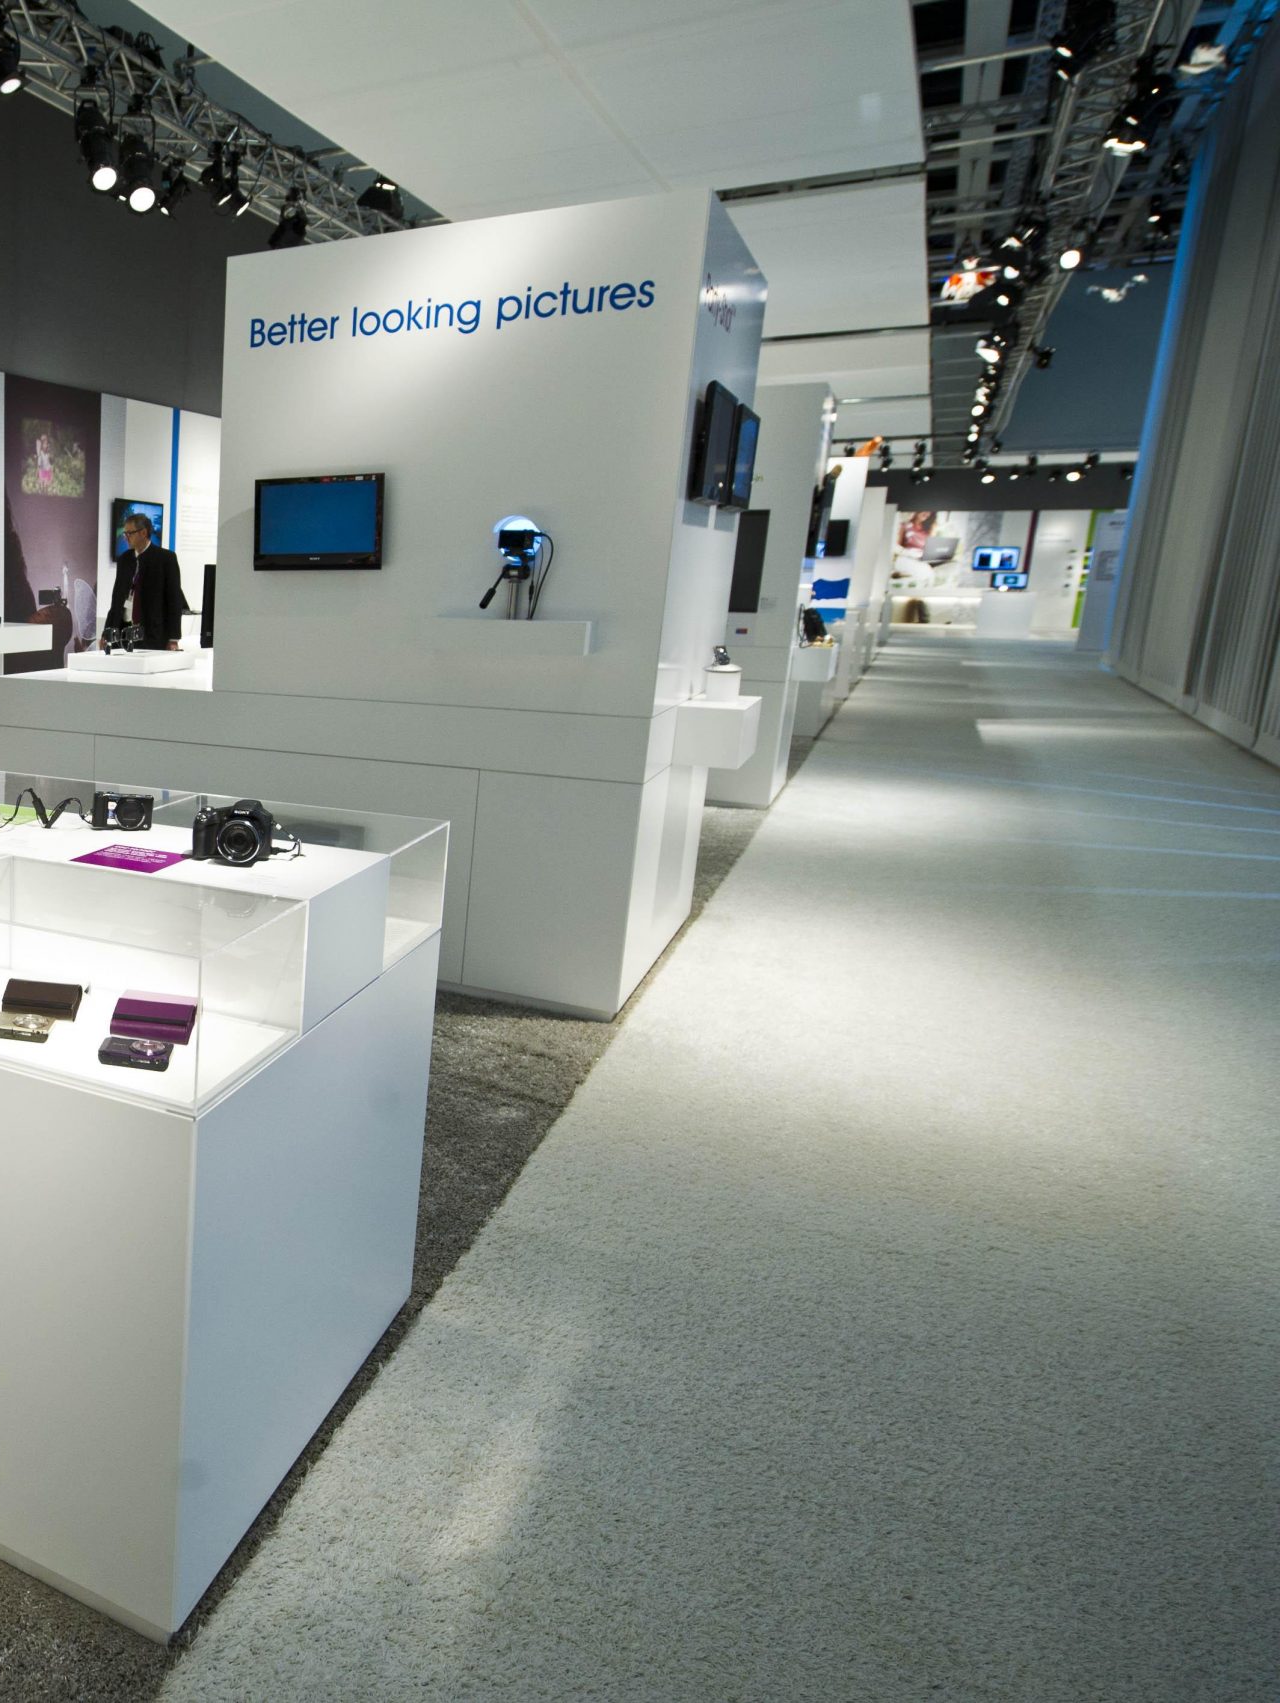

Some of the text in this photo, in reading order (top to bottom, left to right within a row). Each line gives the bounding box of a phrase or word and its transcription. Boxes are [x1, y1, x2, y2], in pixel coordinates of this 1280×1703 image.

[249, 279, 656, 349] Better looking pictures
